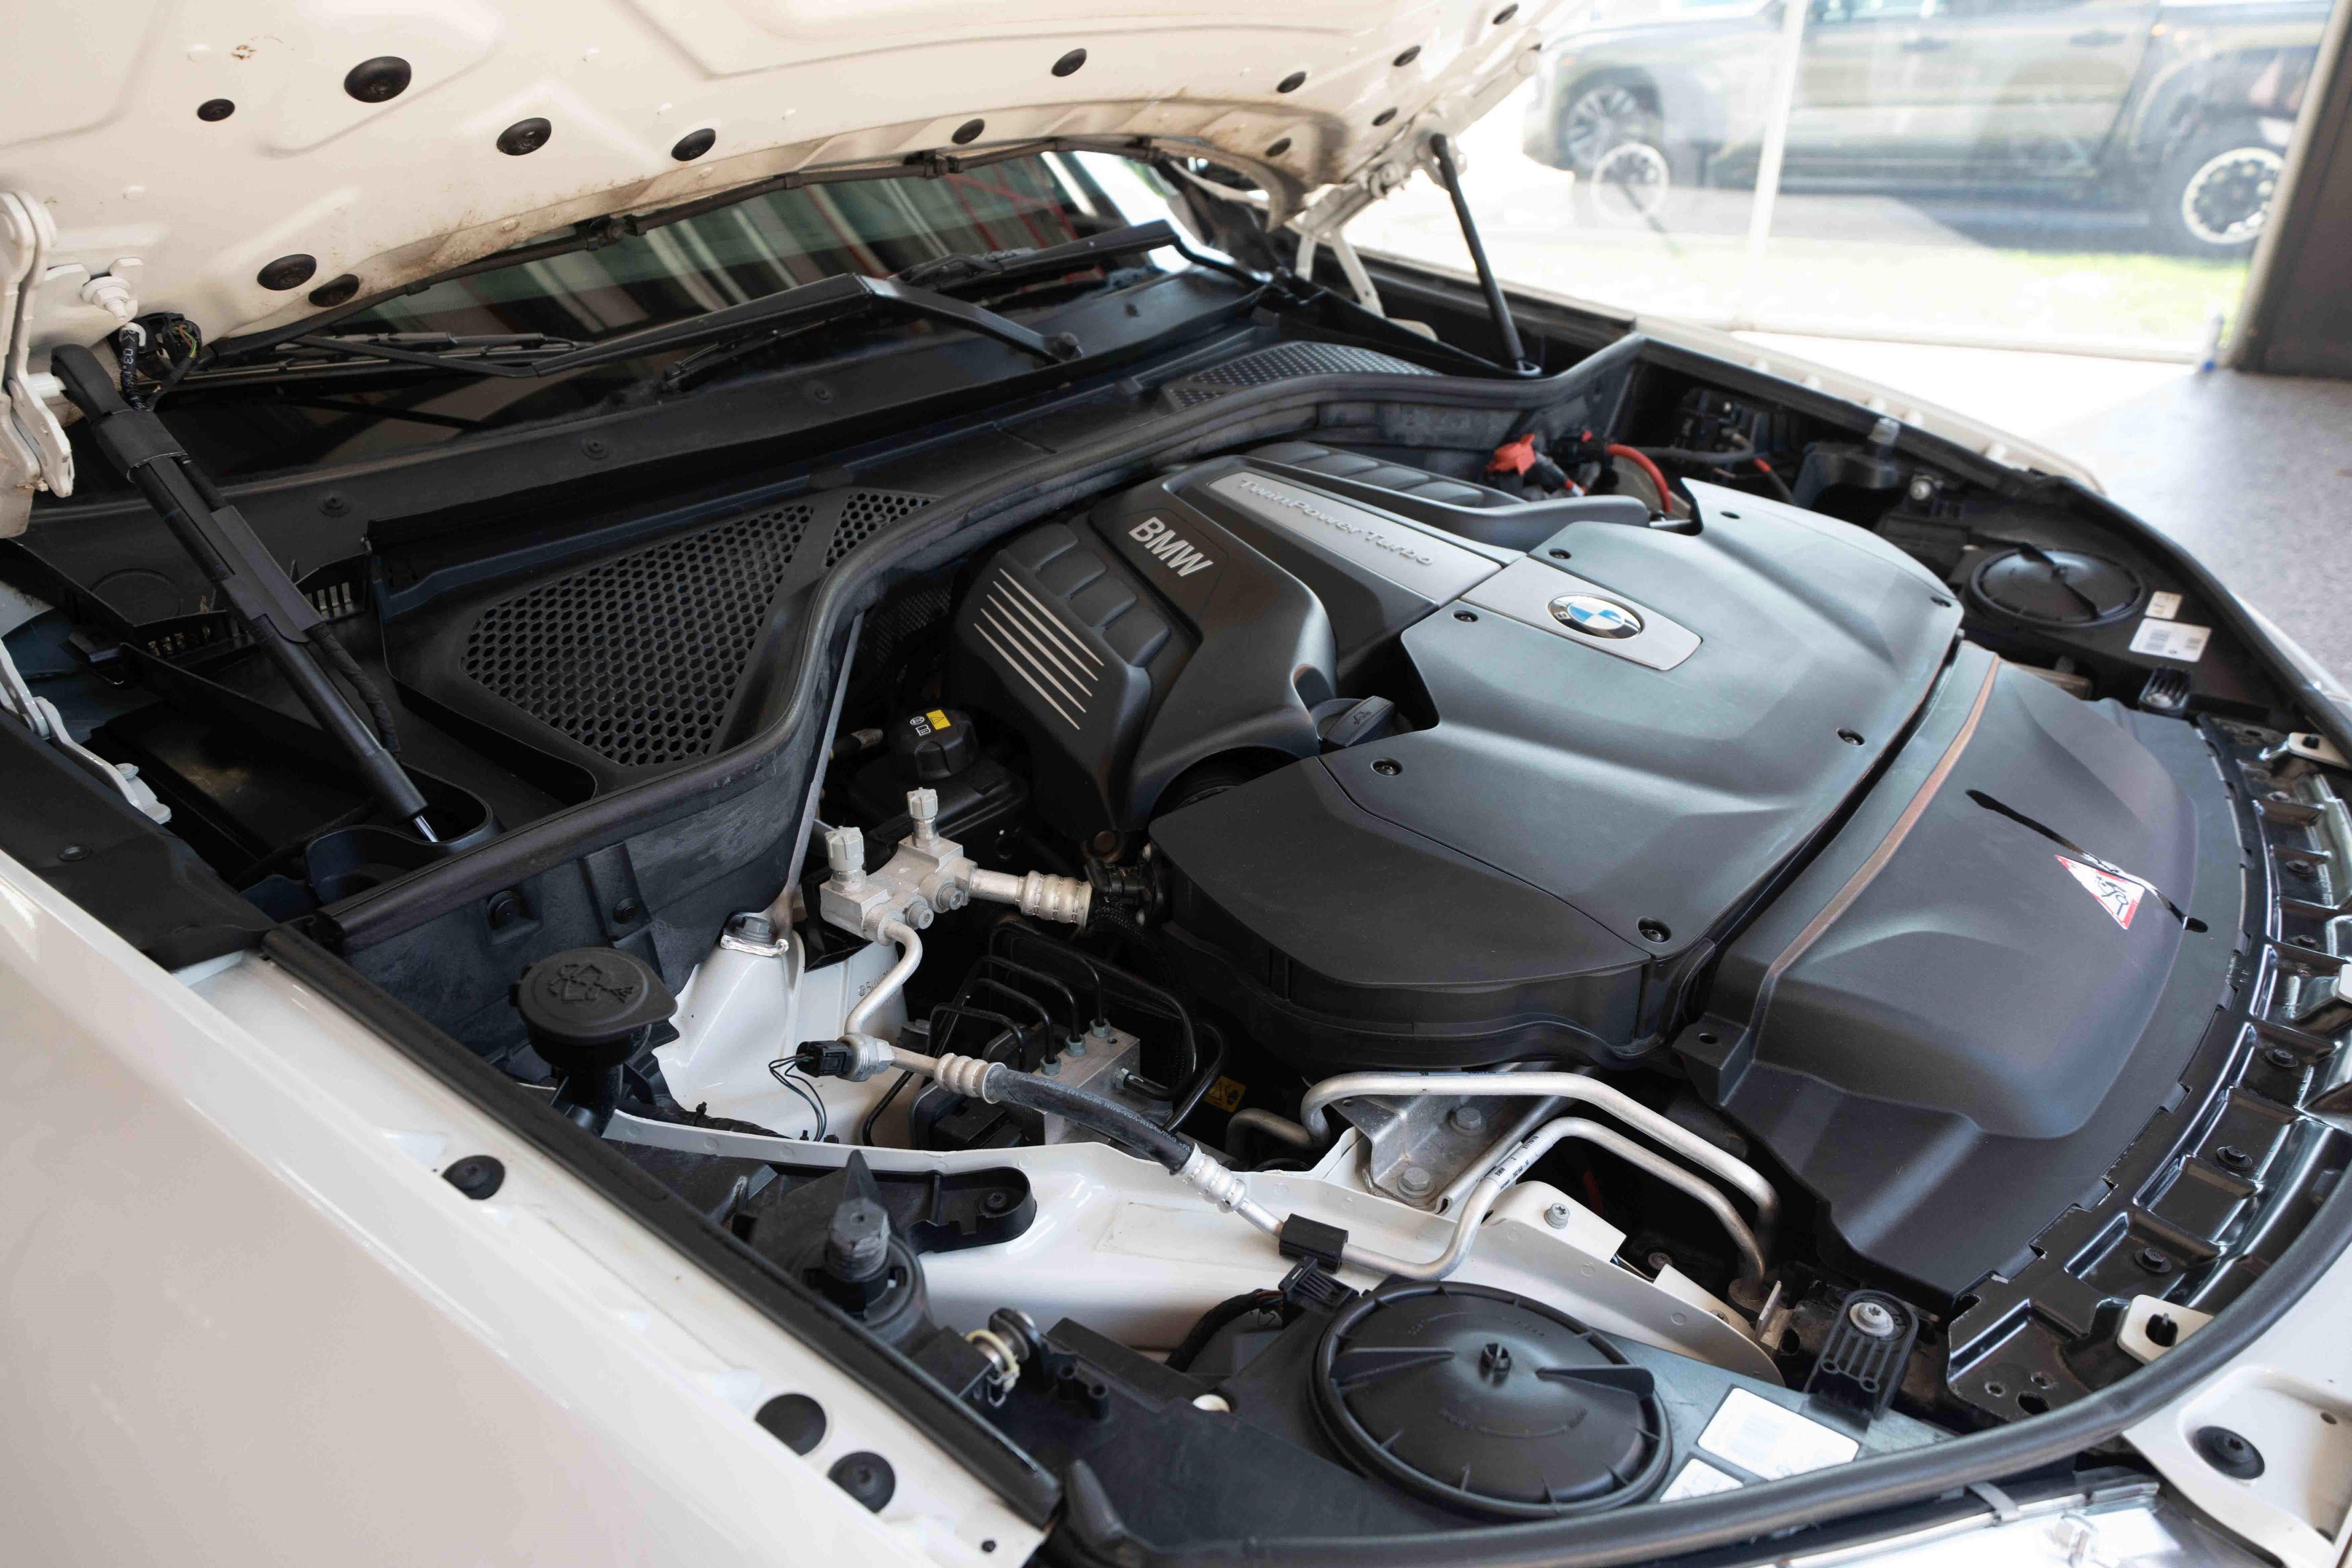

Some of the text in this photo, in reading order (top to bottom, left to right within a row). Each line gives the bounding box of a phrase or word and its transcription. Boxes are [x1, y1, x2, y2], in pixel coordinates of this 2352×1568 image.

[1128, 517, 1213, 577] BMW
[1238, 479, 1432, 565] TwinPower Turbo
